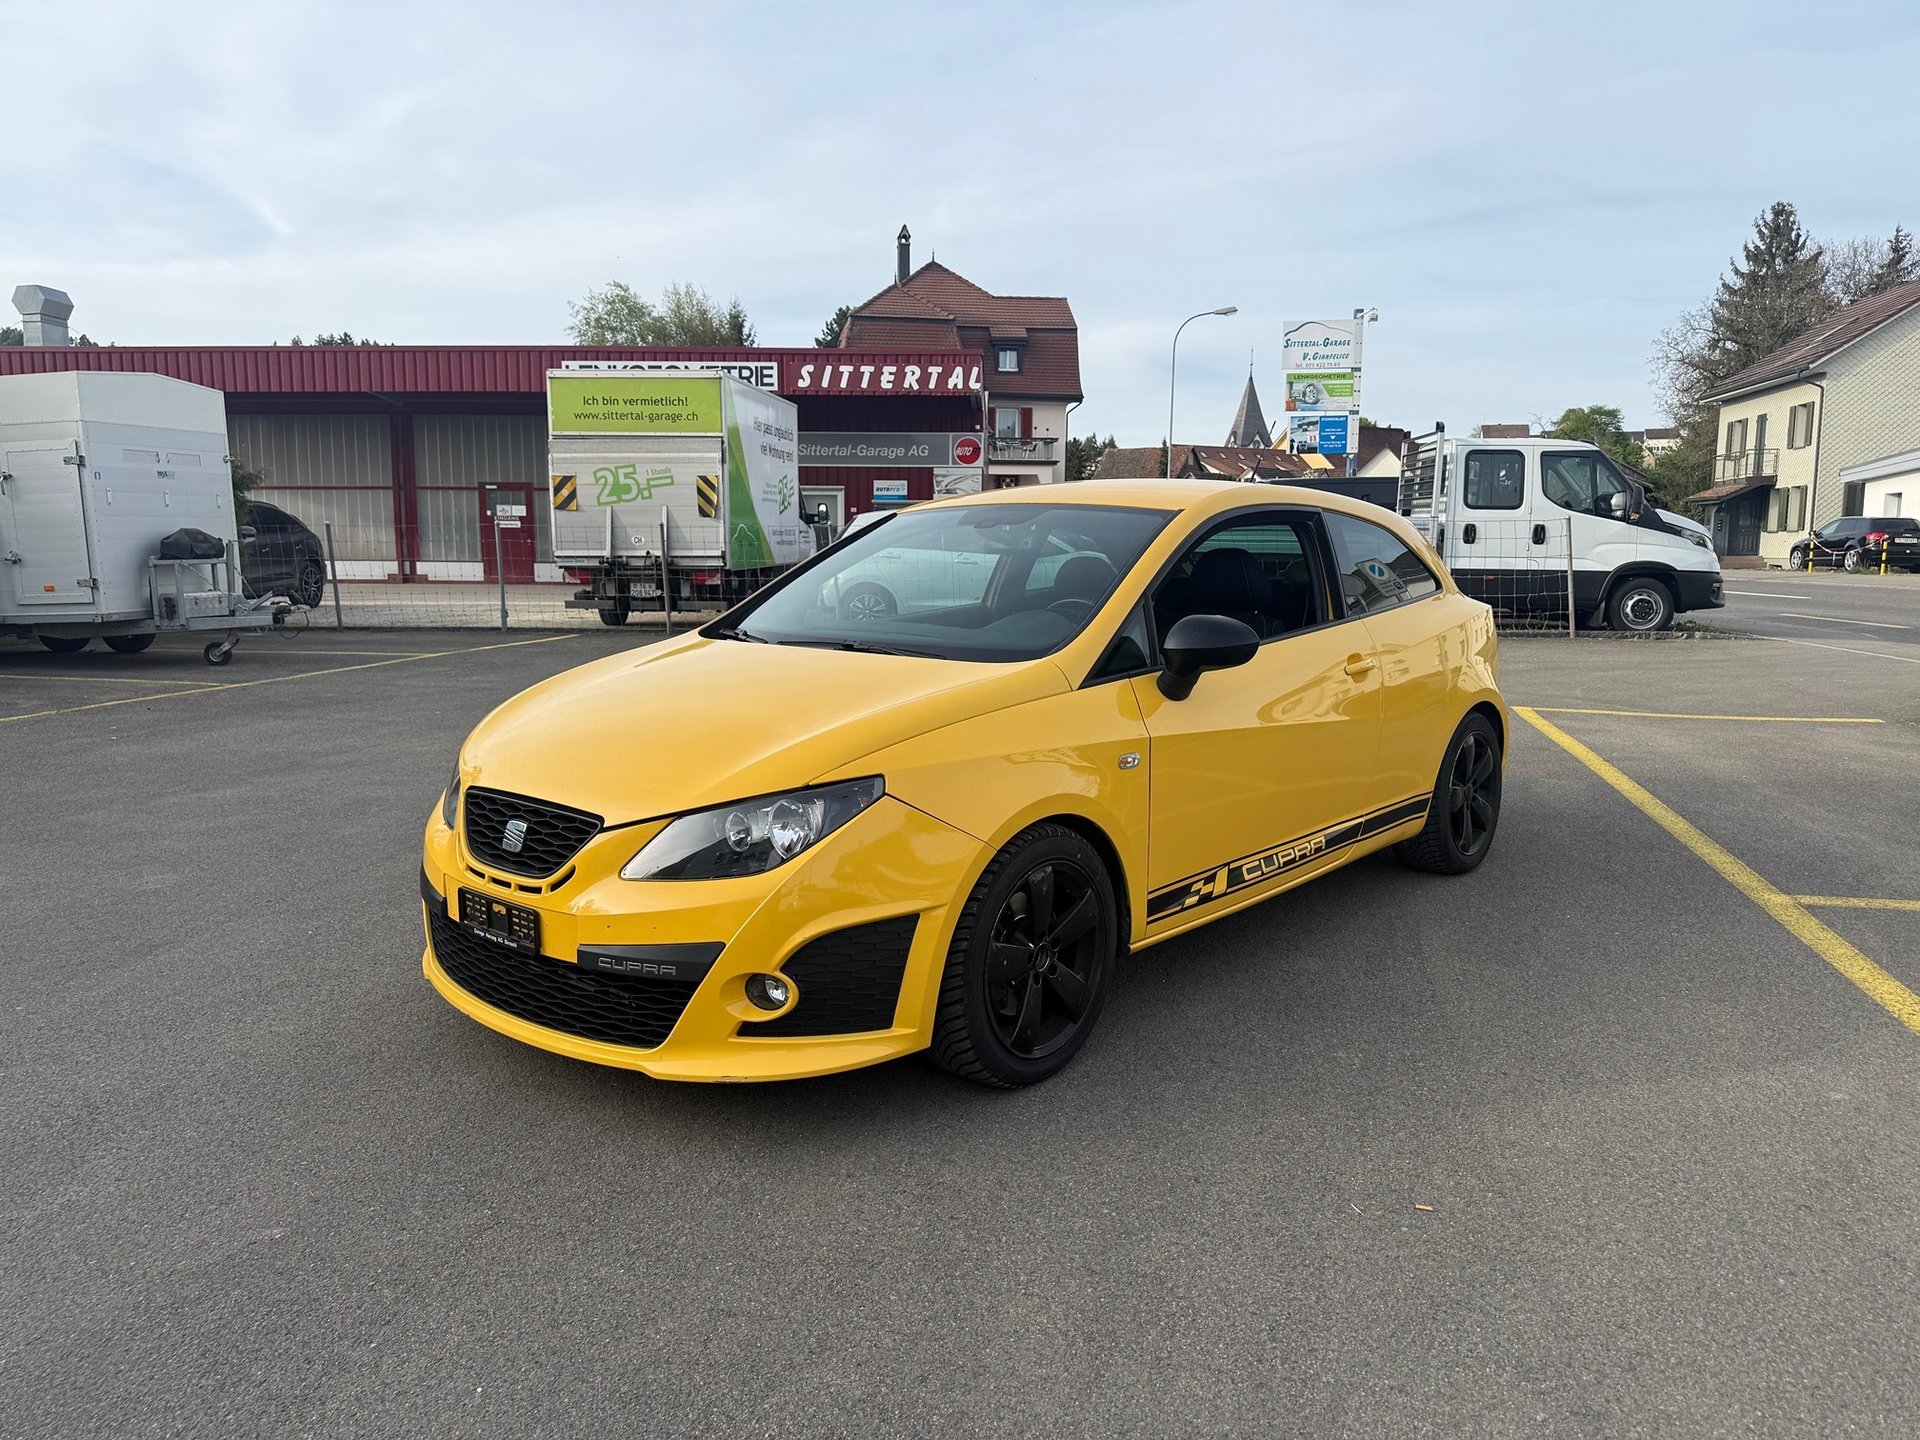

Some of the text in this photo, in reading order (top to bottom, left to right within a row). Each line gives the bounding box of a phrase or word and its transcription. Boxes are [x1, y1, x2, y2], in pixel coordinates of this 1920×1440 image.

[1284, 337, 1351, 348] SITTERTAL-GARAGE
[797, 364, 982, 391] SITTERTAL
[583, 396, 688, 407] Ich bin vermietlich!
[574, 411, 699, 423] www.sittertal-garage.ch
[798, 443, 929, 460] Sittertal-Garage AG
[633, 536, 643, 544] CH
[1242, 835, 1326, 880] CUPRA
[598, 957, 676, 976] CUPRA
